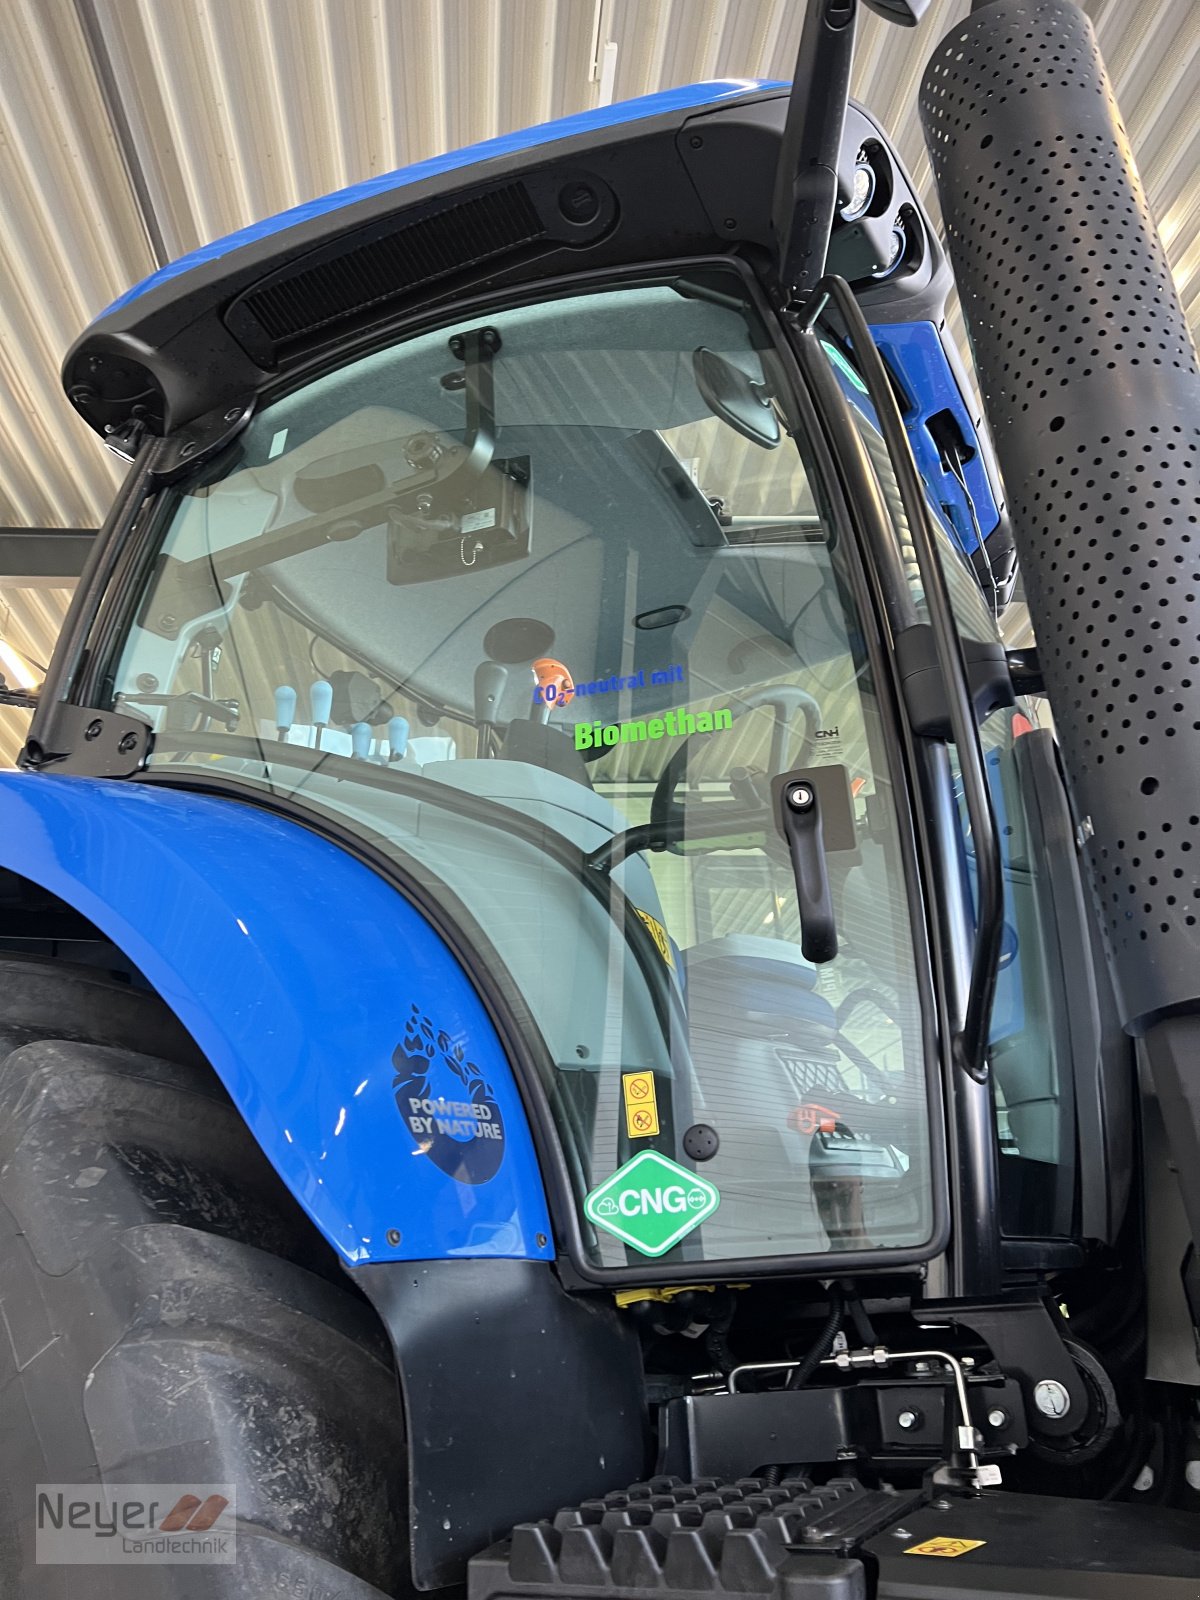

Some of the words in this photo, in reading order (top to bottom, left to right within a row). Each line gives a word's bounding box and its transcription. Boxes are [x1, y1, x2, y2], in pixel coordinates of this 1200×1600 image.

[651, 664, 684, 686] mit
[574, 707, 733, 751] Biomethan
[408, 1098, 492, 1120] POWERED
[408, 1116, 433, 1134] BY
[436, 1118, 503, 1140] NATURE
[618, 1185, 687, 1217] CNG
